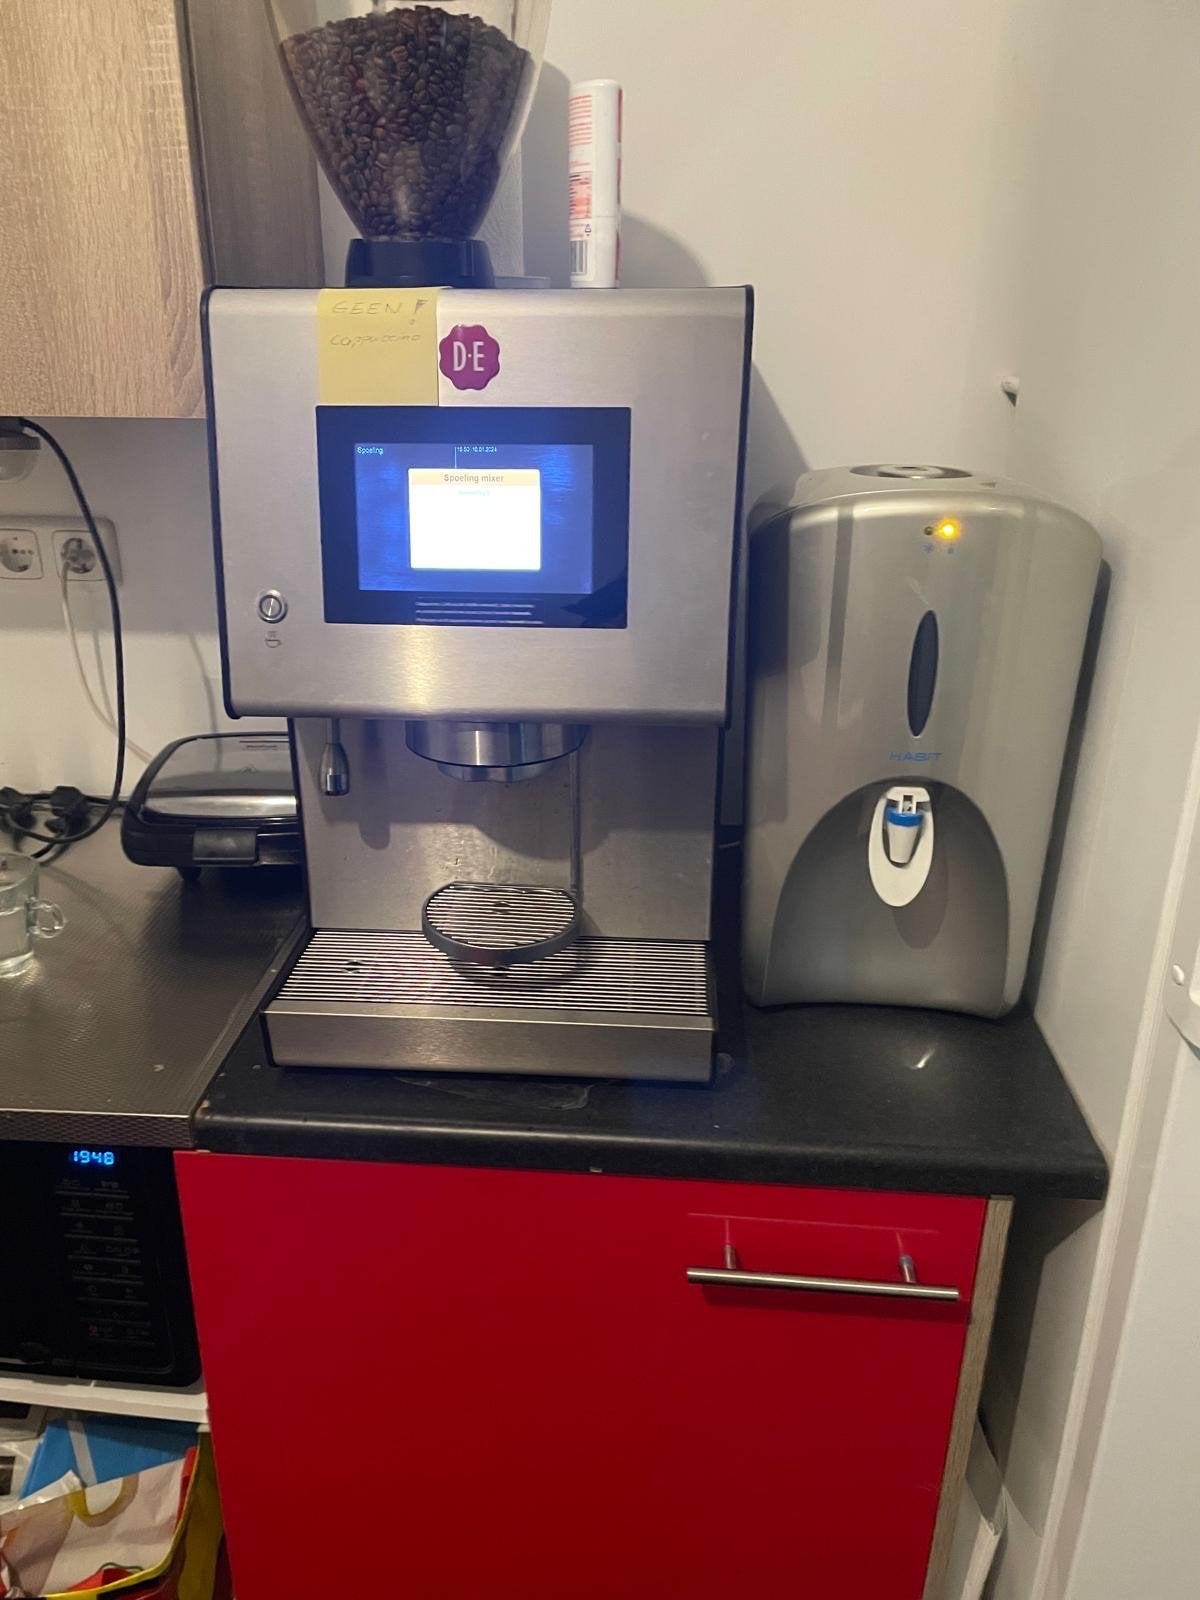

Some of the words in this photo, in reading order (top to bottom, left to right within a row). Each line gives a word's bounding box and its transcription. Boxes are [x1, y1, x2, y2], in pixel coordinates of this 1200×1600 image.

[357, 446, 383, 455] Spoeling
[443, 473, 479, 484] Spoeling
[481, 473, 504, 482] mixer
[888, 752, 943, 761] HABIT
